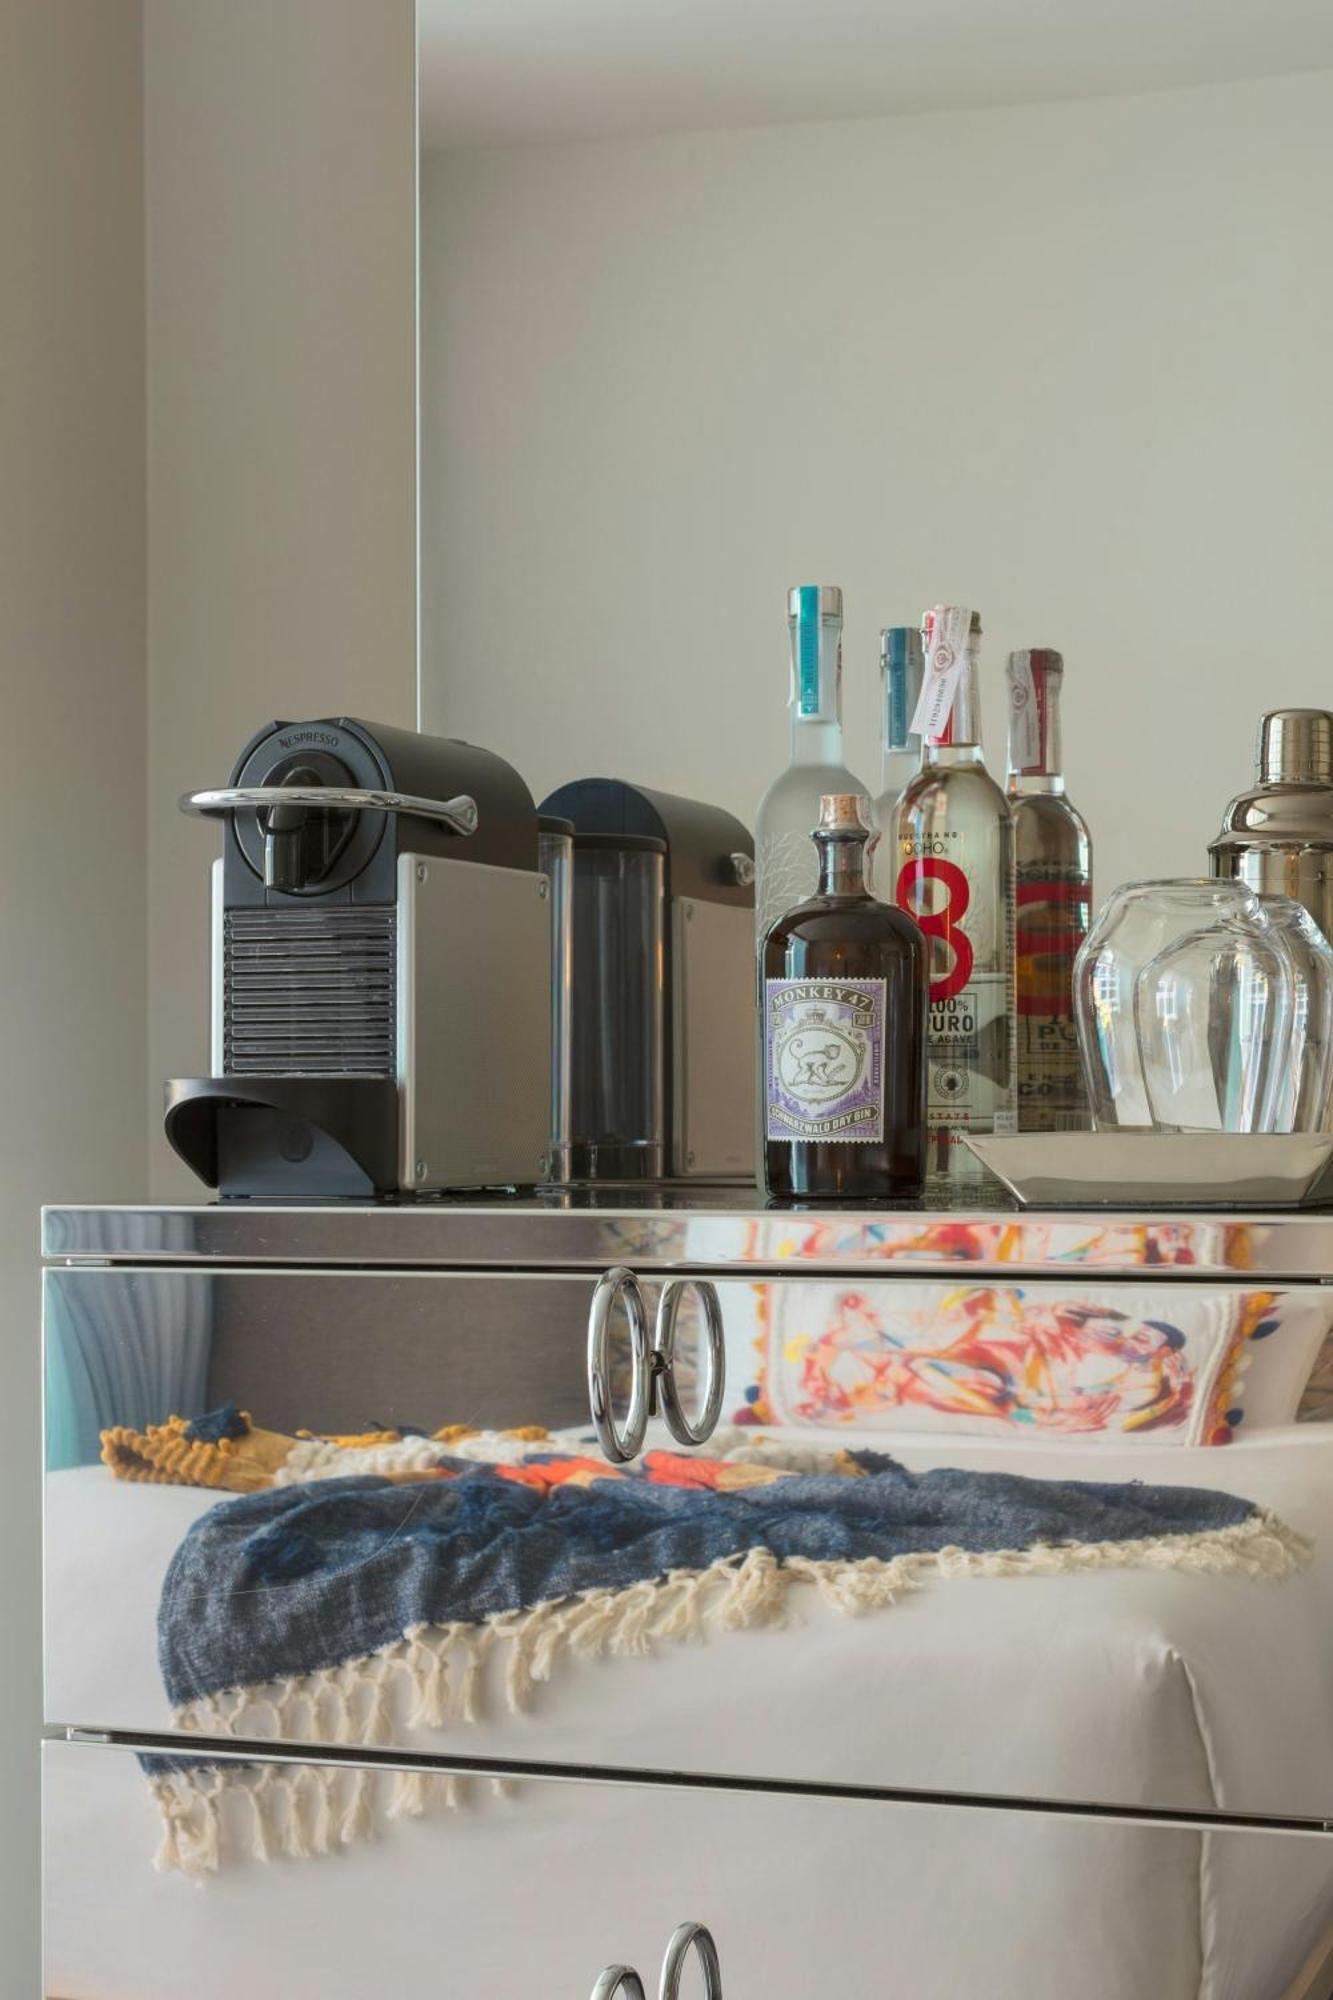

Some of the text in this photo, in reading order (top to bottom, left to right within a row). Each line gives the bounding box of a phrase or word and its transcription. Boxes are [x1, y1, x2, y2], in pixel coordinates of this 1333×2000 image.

[278, 731, 338, 748] NESPRESSO
[896, 857, 974, 1003] 8
[774, 987, 871, 1009] MONKEY 47
[928, 1015, 974, 1032] URO
[770, 1106, 872, 1133] SCHWARZWALD DRY GIN
